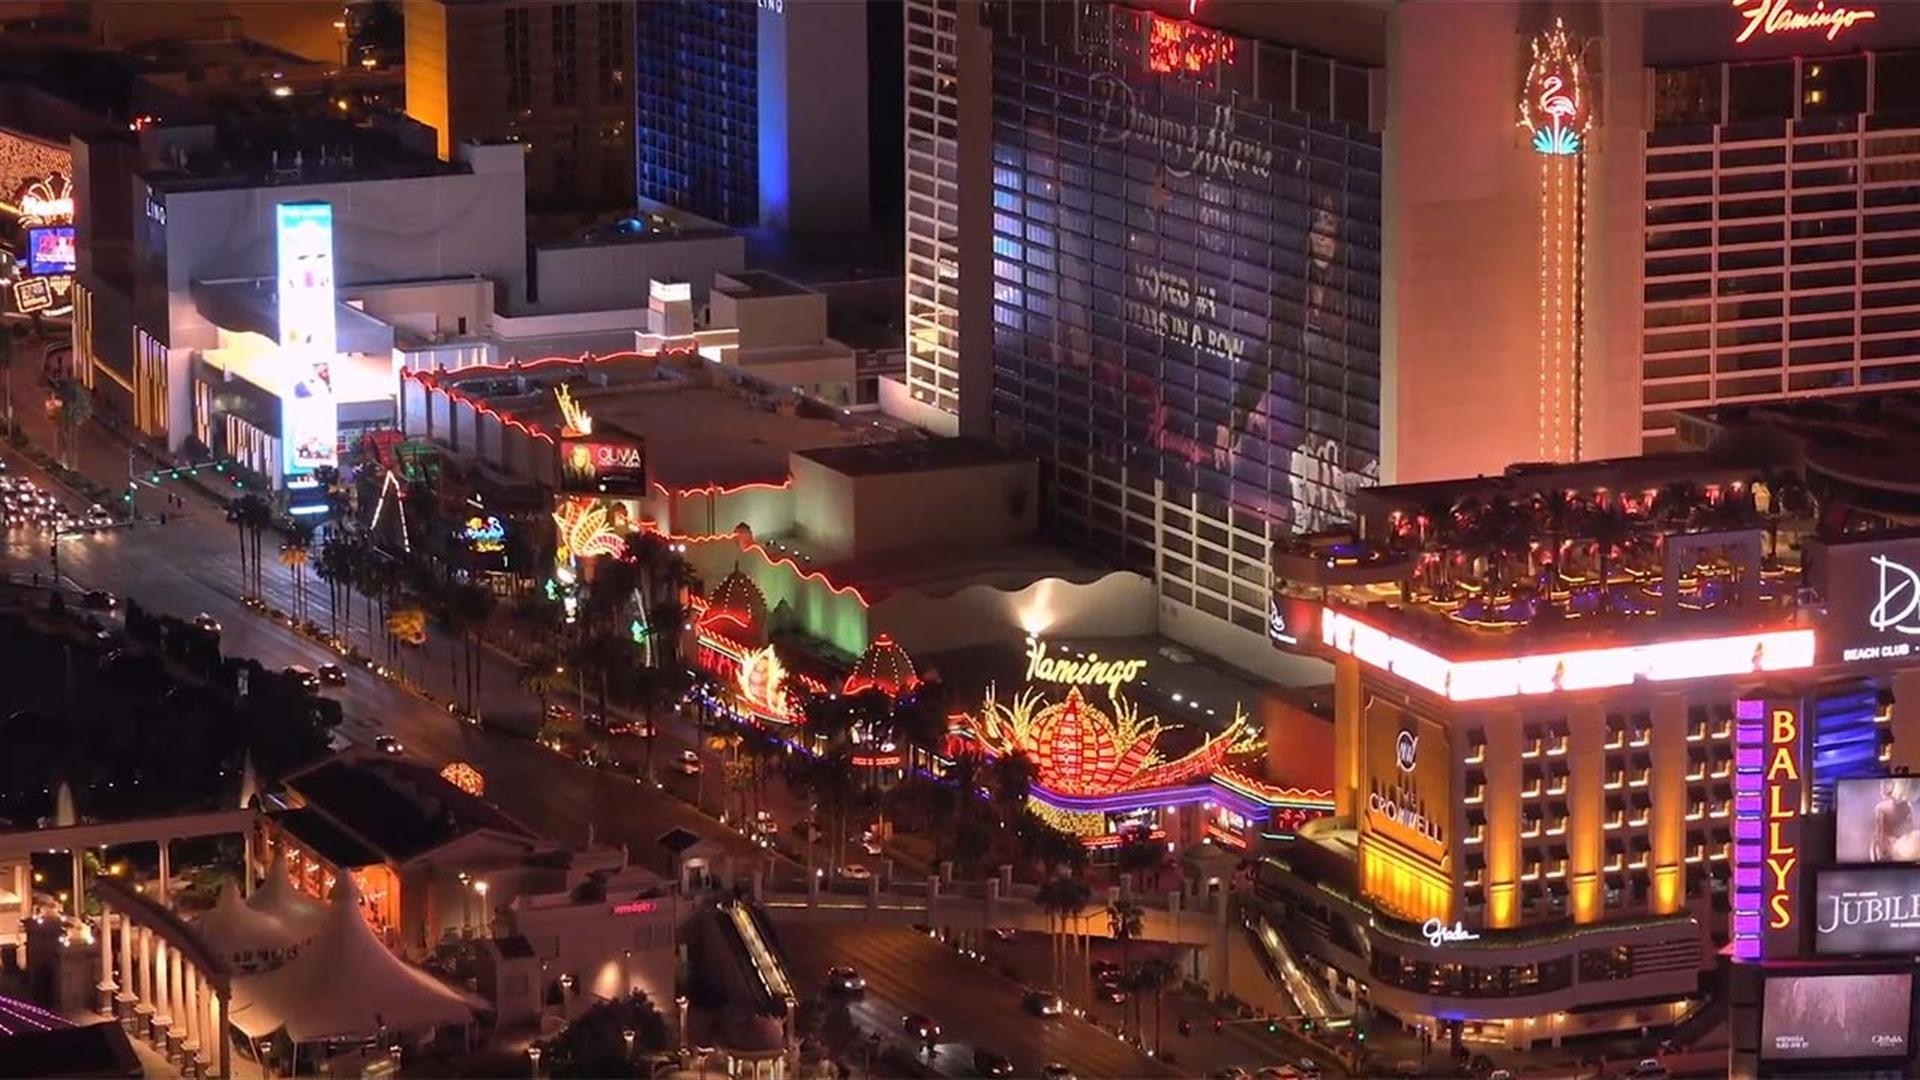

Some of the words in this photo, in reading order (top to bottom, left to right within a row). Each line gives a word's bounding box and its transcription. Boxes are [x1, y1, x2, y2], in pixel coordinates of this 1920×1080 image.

[1733, 0, 1875, 42] Flamingo
[1190, 323, 1203, 347] A
[1206, 328, 1245, 363] ROW
[1026, 637, 1147, 700] Flamingo
[1843, 646, 1880, 661] BEACH
[1882, 643, 1910, 657] CLUB
[1369, 792, 1443, 845] CROMWELL
[1767, 711, 1798, 929] BALLYS
